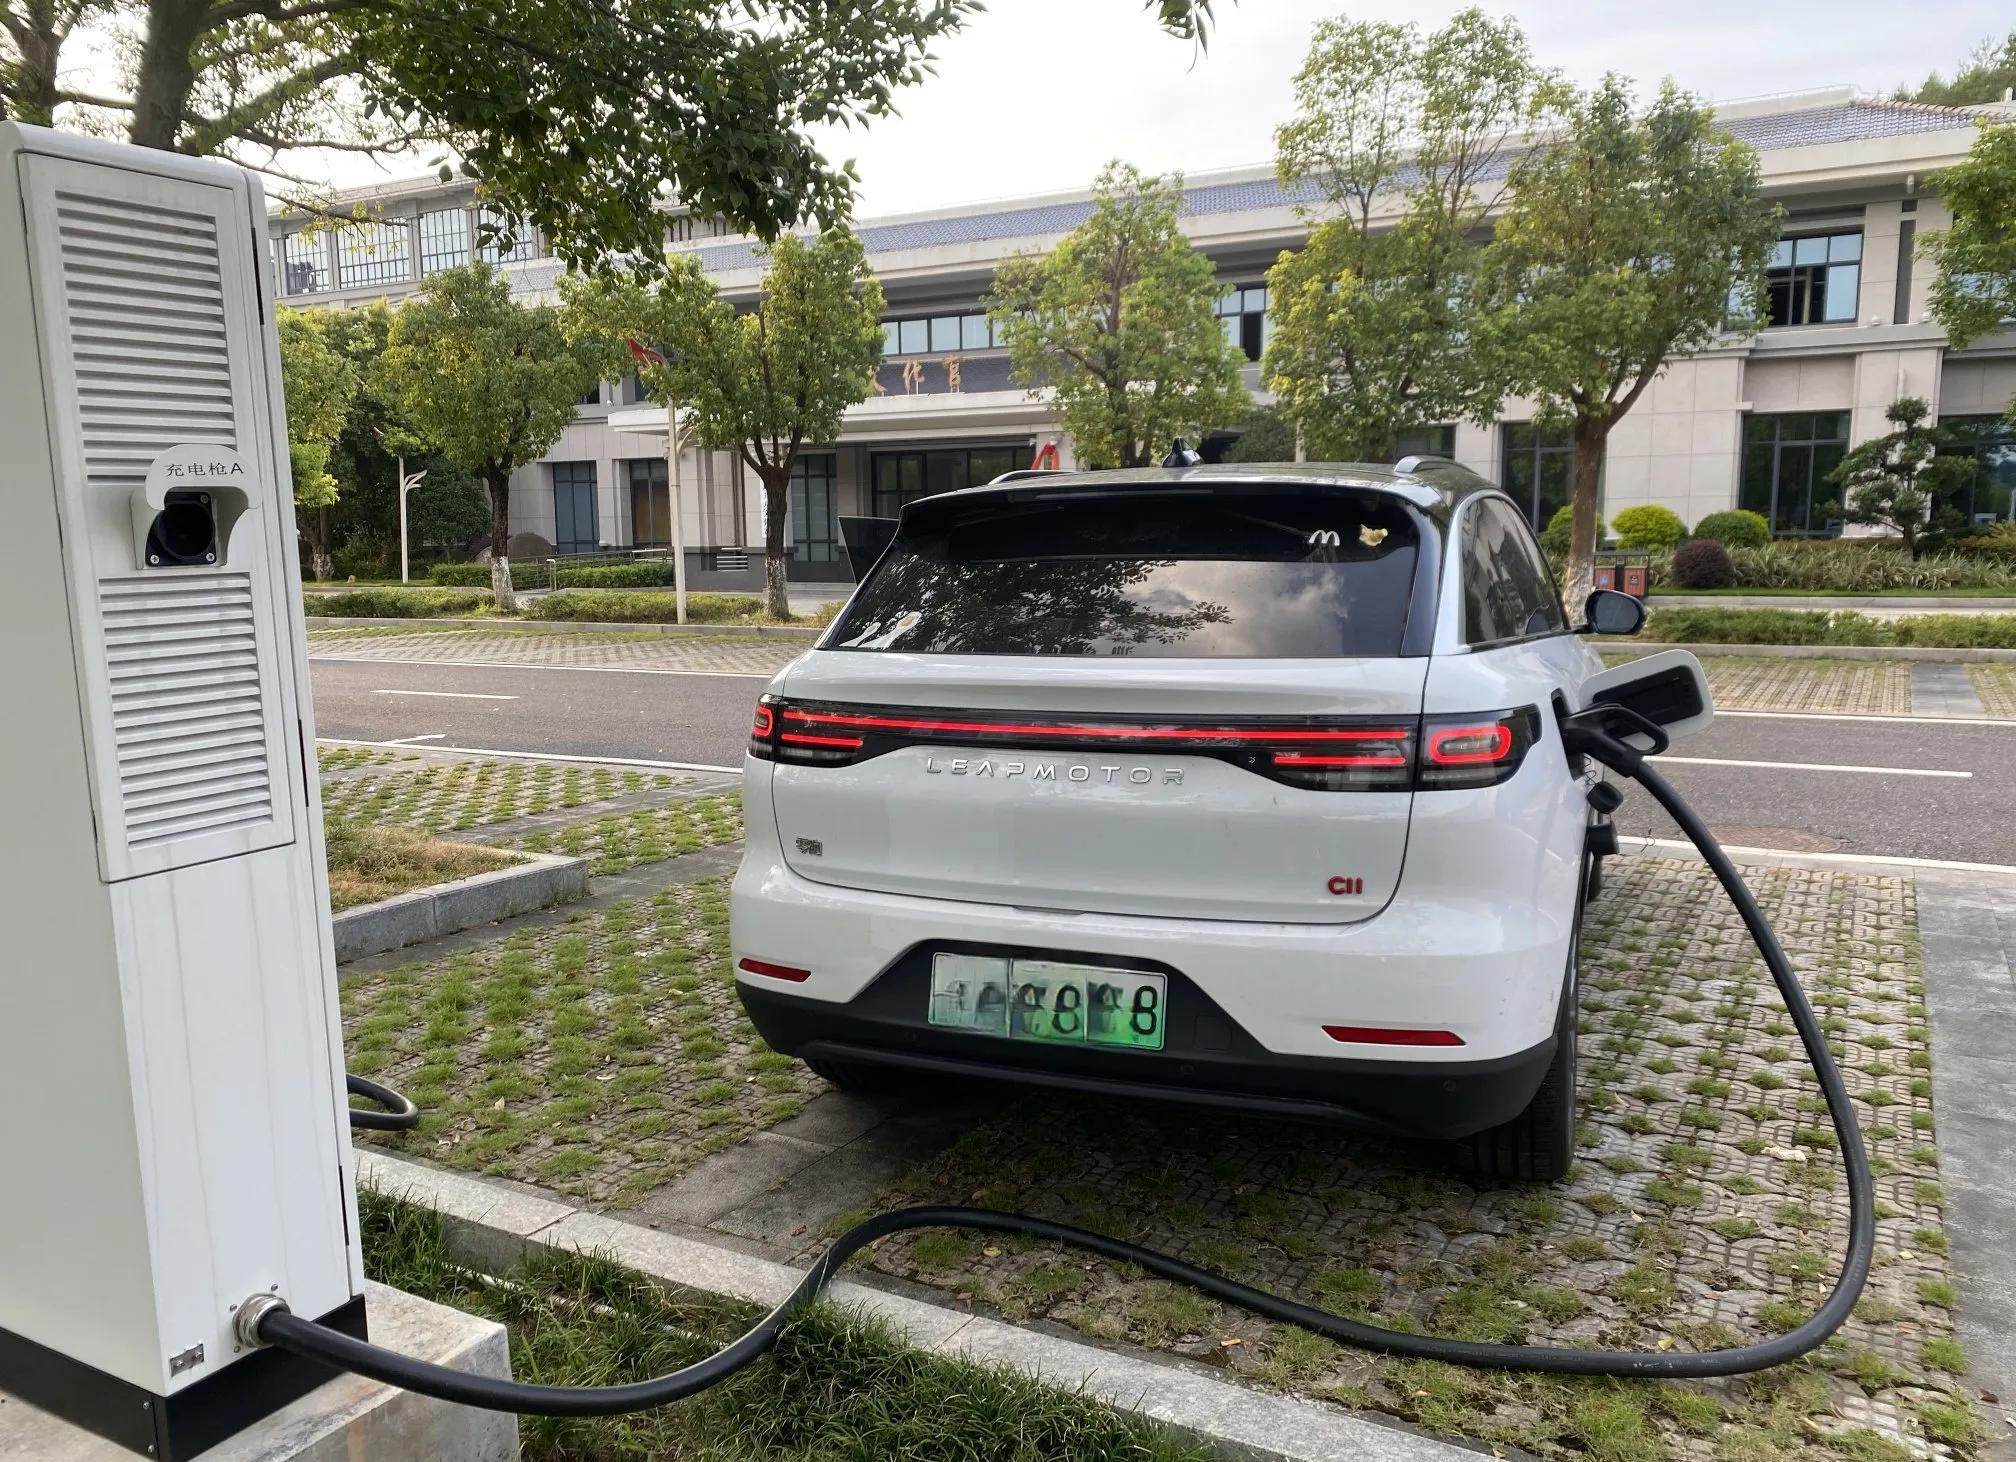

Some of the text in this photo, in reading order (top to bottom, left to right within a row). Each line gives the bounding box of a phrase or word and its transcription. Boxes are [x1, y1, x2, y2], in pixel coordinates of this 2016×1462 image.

[165, 462, 244, 477] 充电枪A
[926, 757, 1185, 785] LEAPMOTOR
